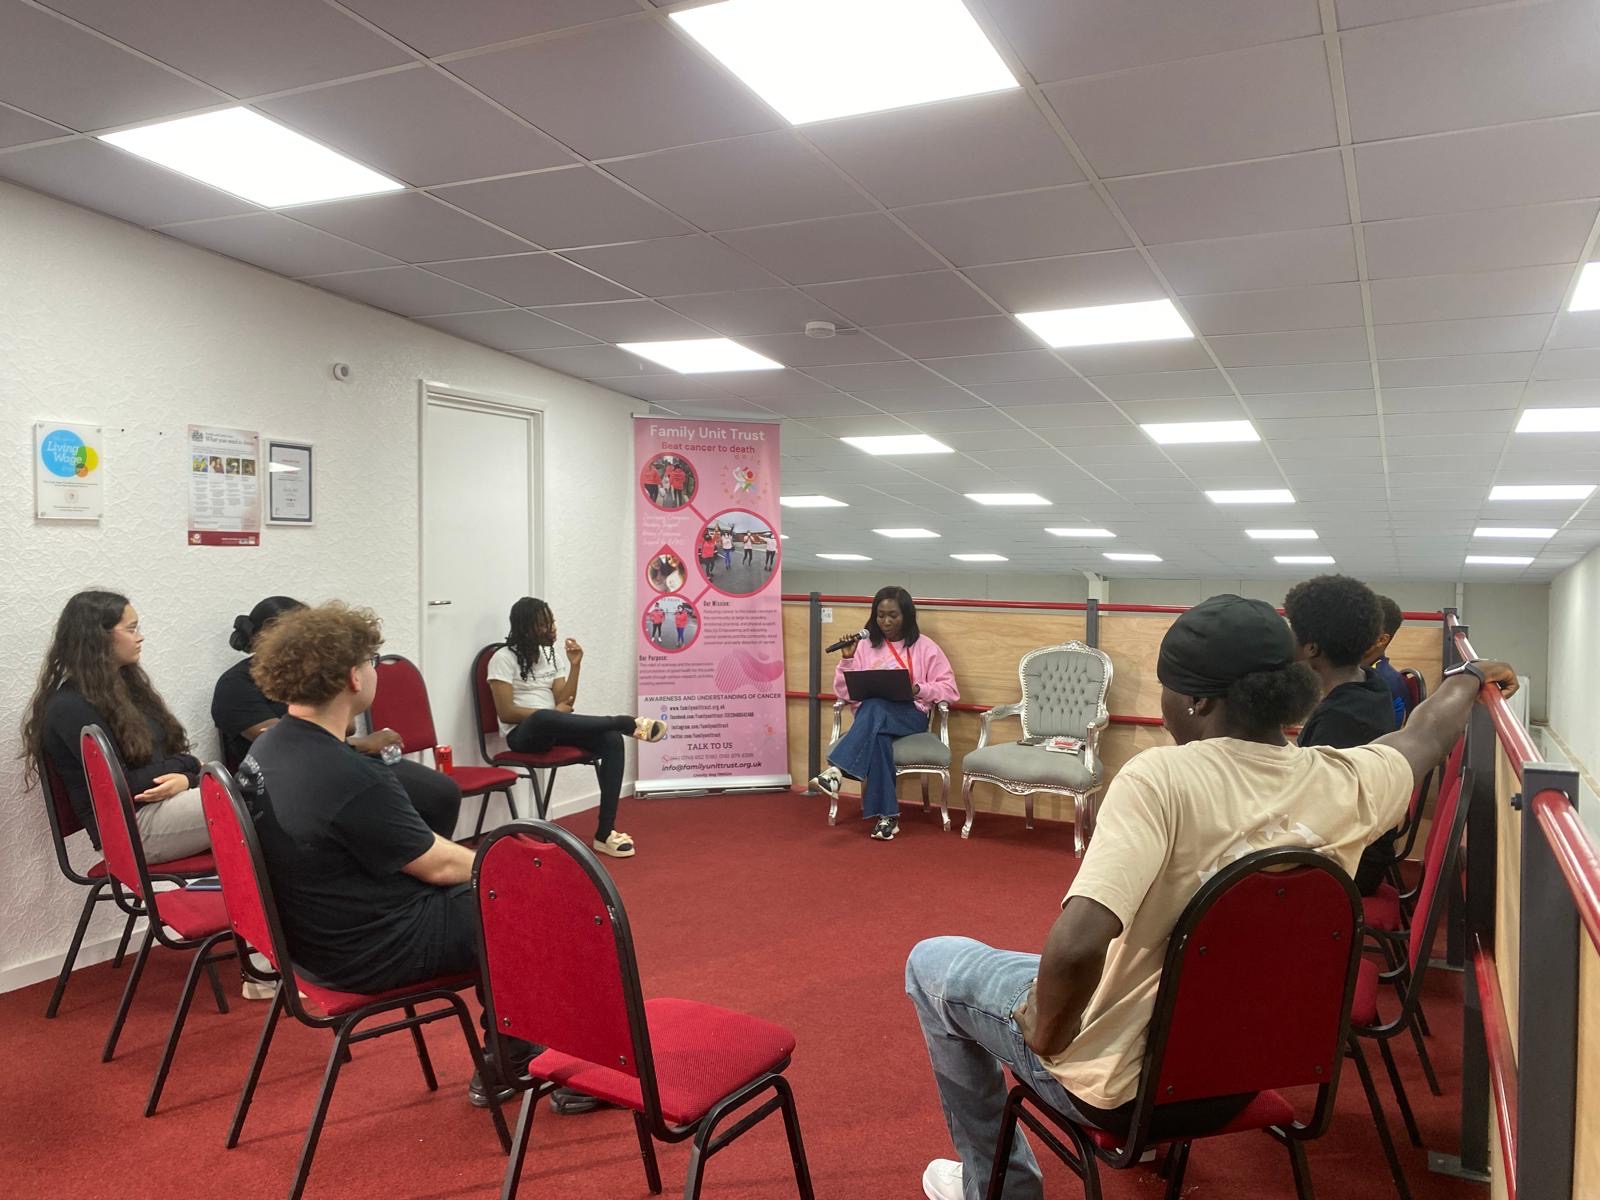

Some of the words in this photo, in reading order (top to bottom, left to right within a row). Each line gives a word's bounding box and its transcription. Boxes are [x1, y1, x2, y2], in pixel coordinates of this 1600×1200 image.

[650, 424, 695, 441] Family
[699, 427, 727, 439] Unit
[730, 428, 765, 441] Trust
[48, 440, 79, 453] Living
[661, 441, 682, 450] Beat
[684, 444, 715, 452] cancer
[717, 445, 727, 453] to
[730, 445, 755, 454] death
[54, 451, 82, 465] Wage
[661, 761, 762, 772] info@familyunittrust.org.uk
